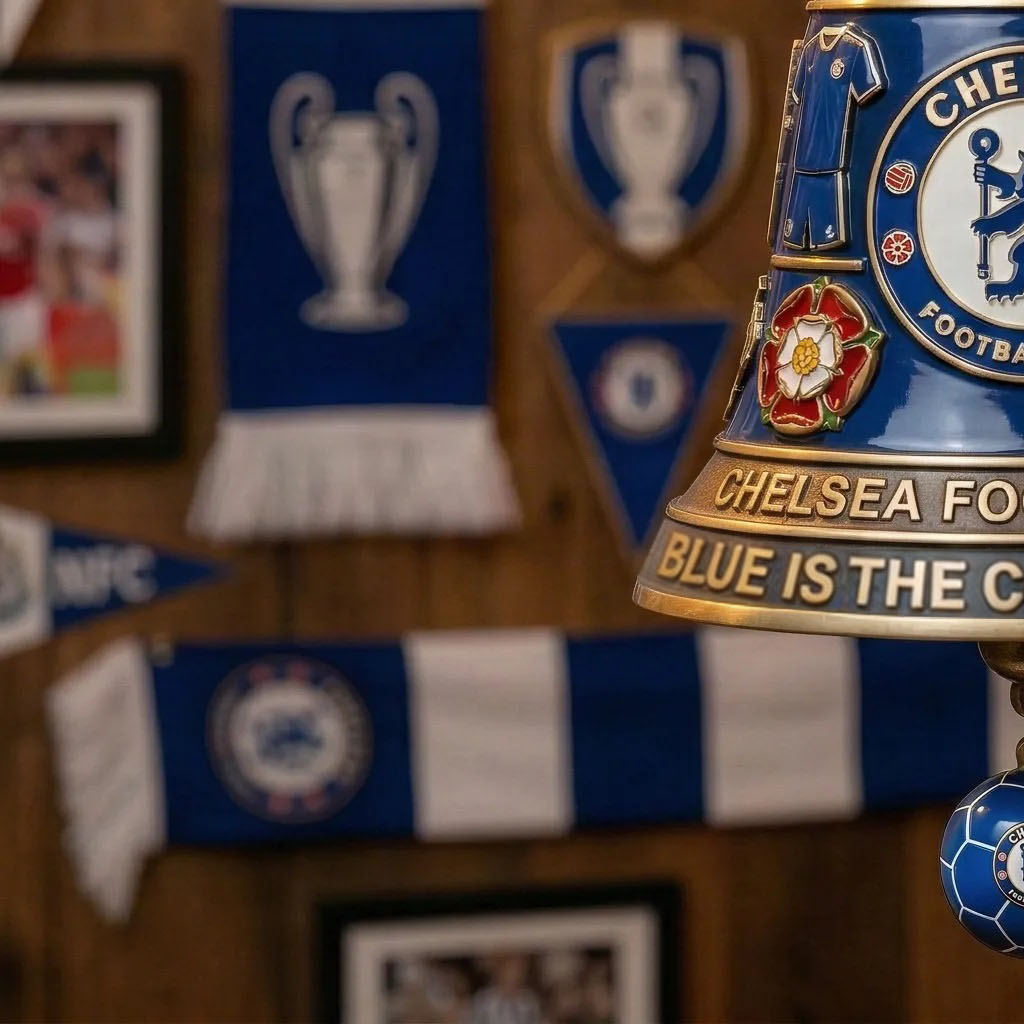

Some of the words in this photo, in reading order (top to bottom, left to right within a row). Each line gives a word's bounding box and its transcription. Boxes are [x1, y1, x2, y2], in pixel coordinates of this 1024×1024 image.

[713, 467, 921, 523] CHELSEA
[657, 531, 776, 599] BLUE
[782, 553, 837, 607] IS
[848, 555, 967, 613] THE
